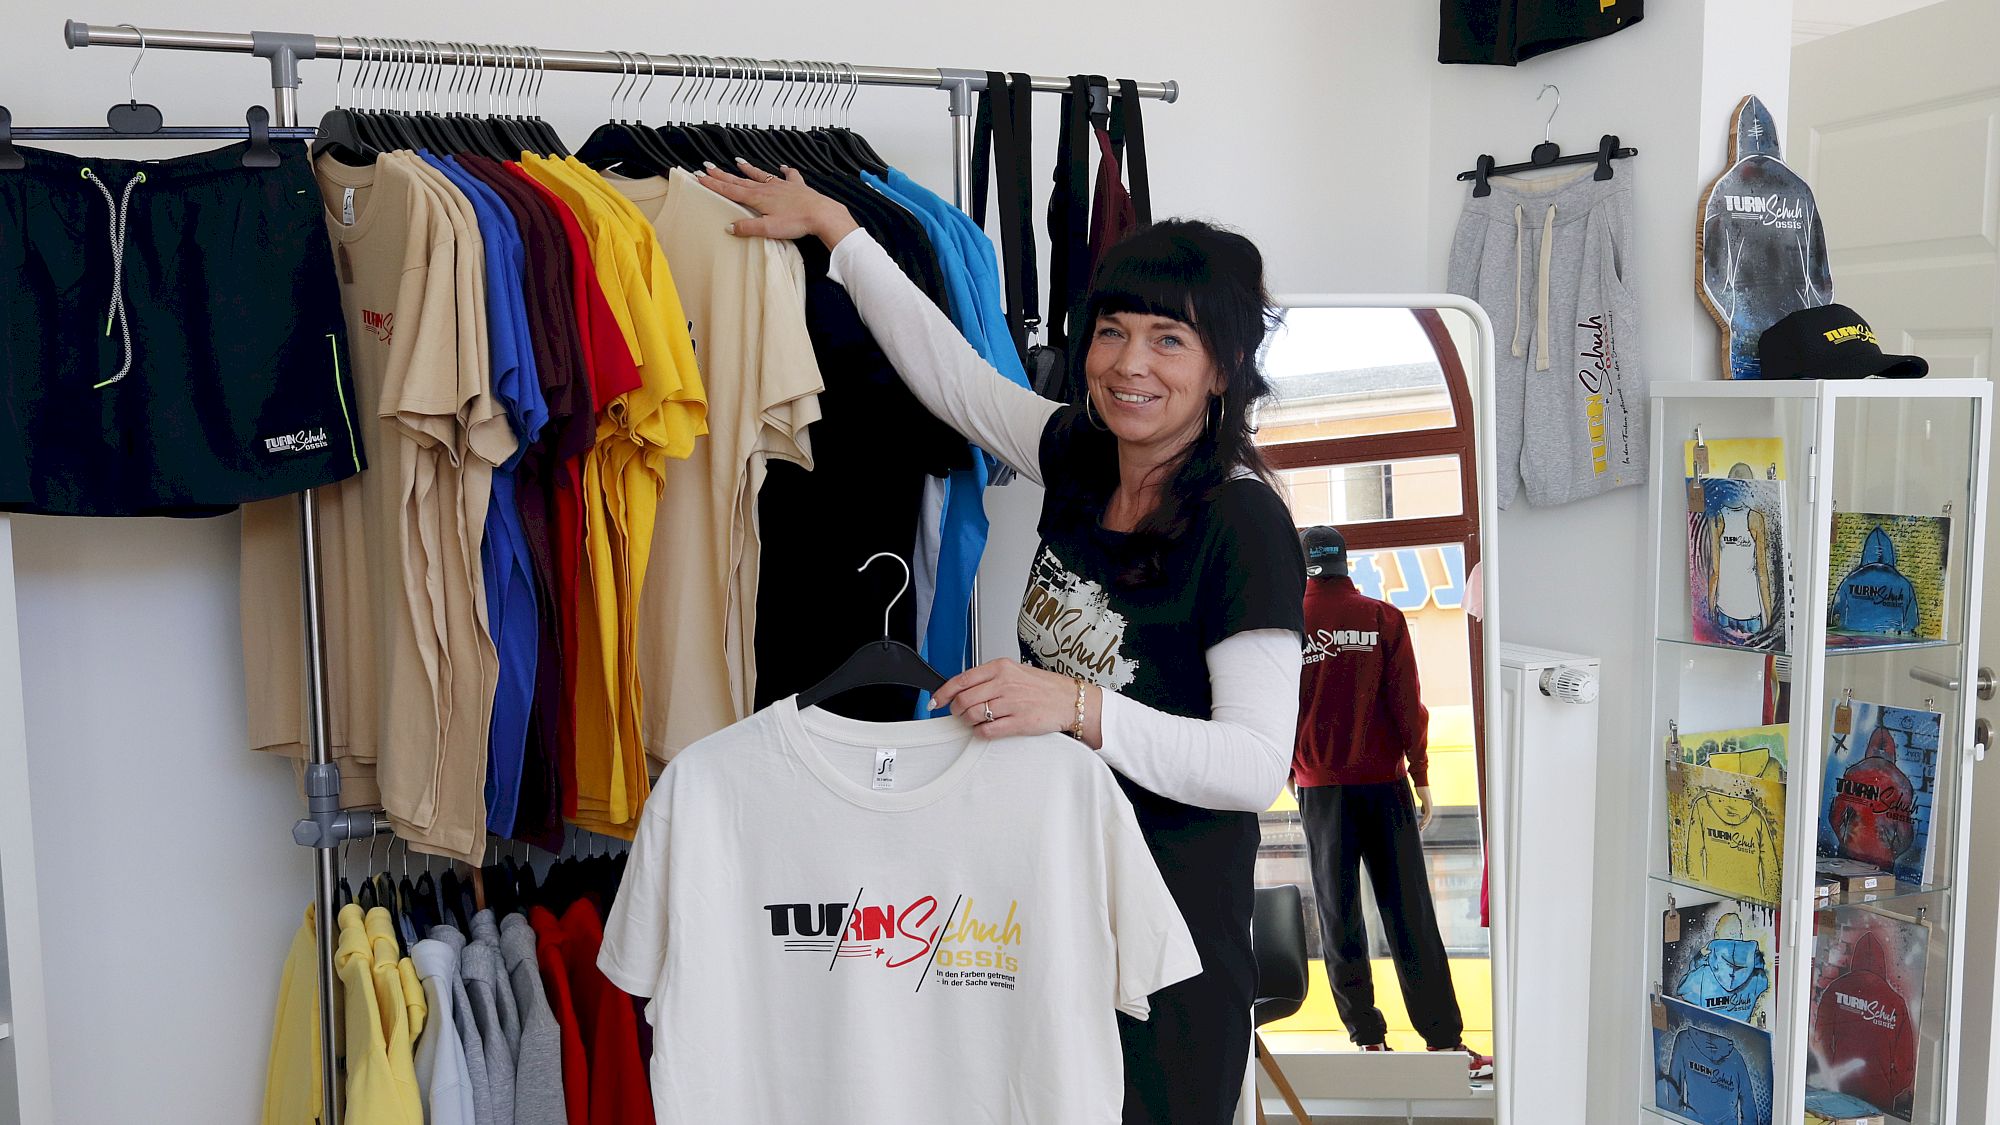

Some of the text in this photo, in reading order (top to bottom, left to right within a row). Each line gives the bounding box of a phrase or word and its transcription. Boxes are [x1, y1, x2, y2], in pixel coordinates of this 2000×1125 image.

[945, 970, 959, 978] den
[960, 970, 986, 978] Farben
[987, 972, 1015, 983] getrennt
[942, 978, 949, 986] in
[951, 979, 963, 987] der
[990, 980, 1015, 991] vereint!
